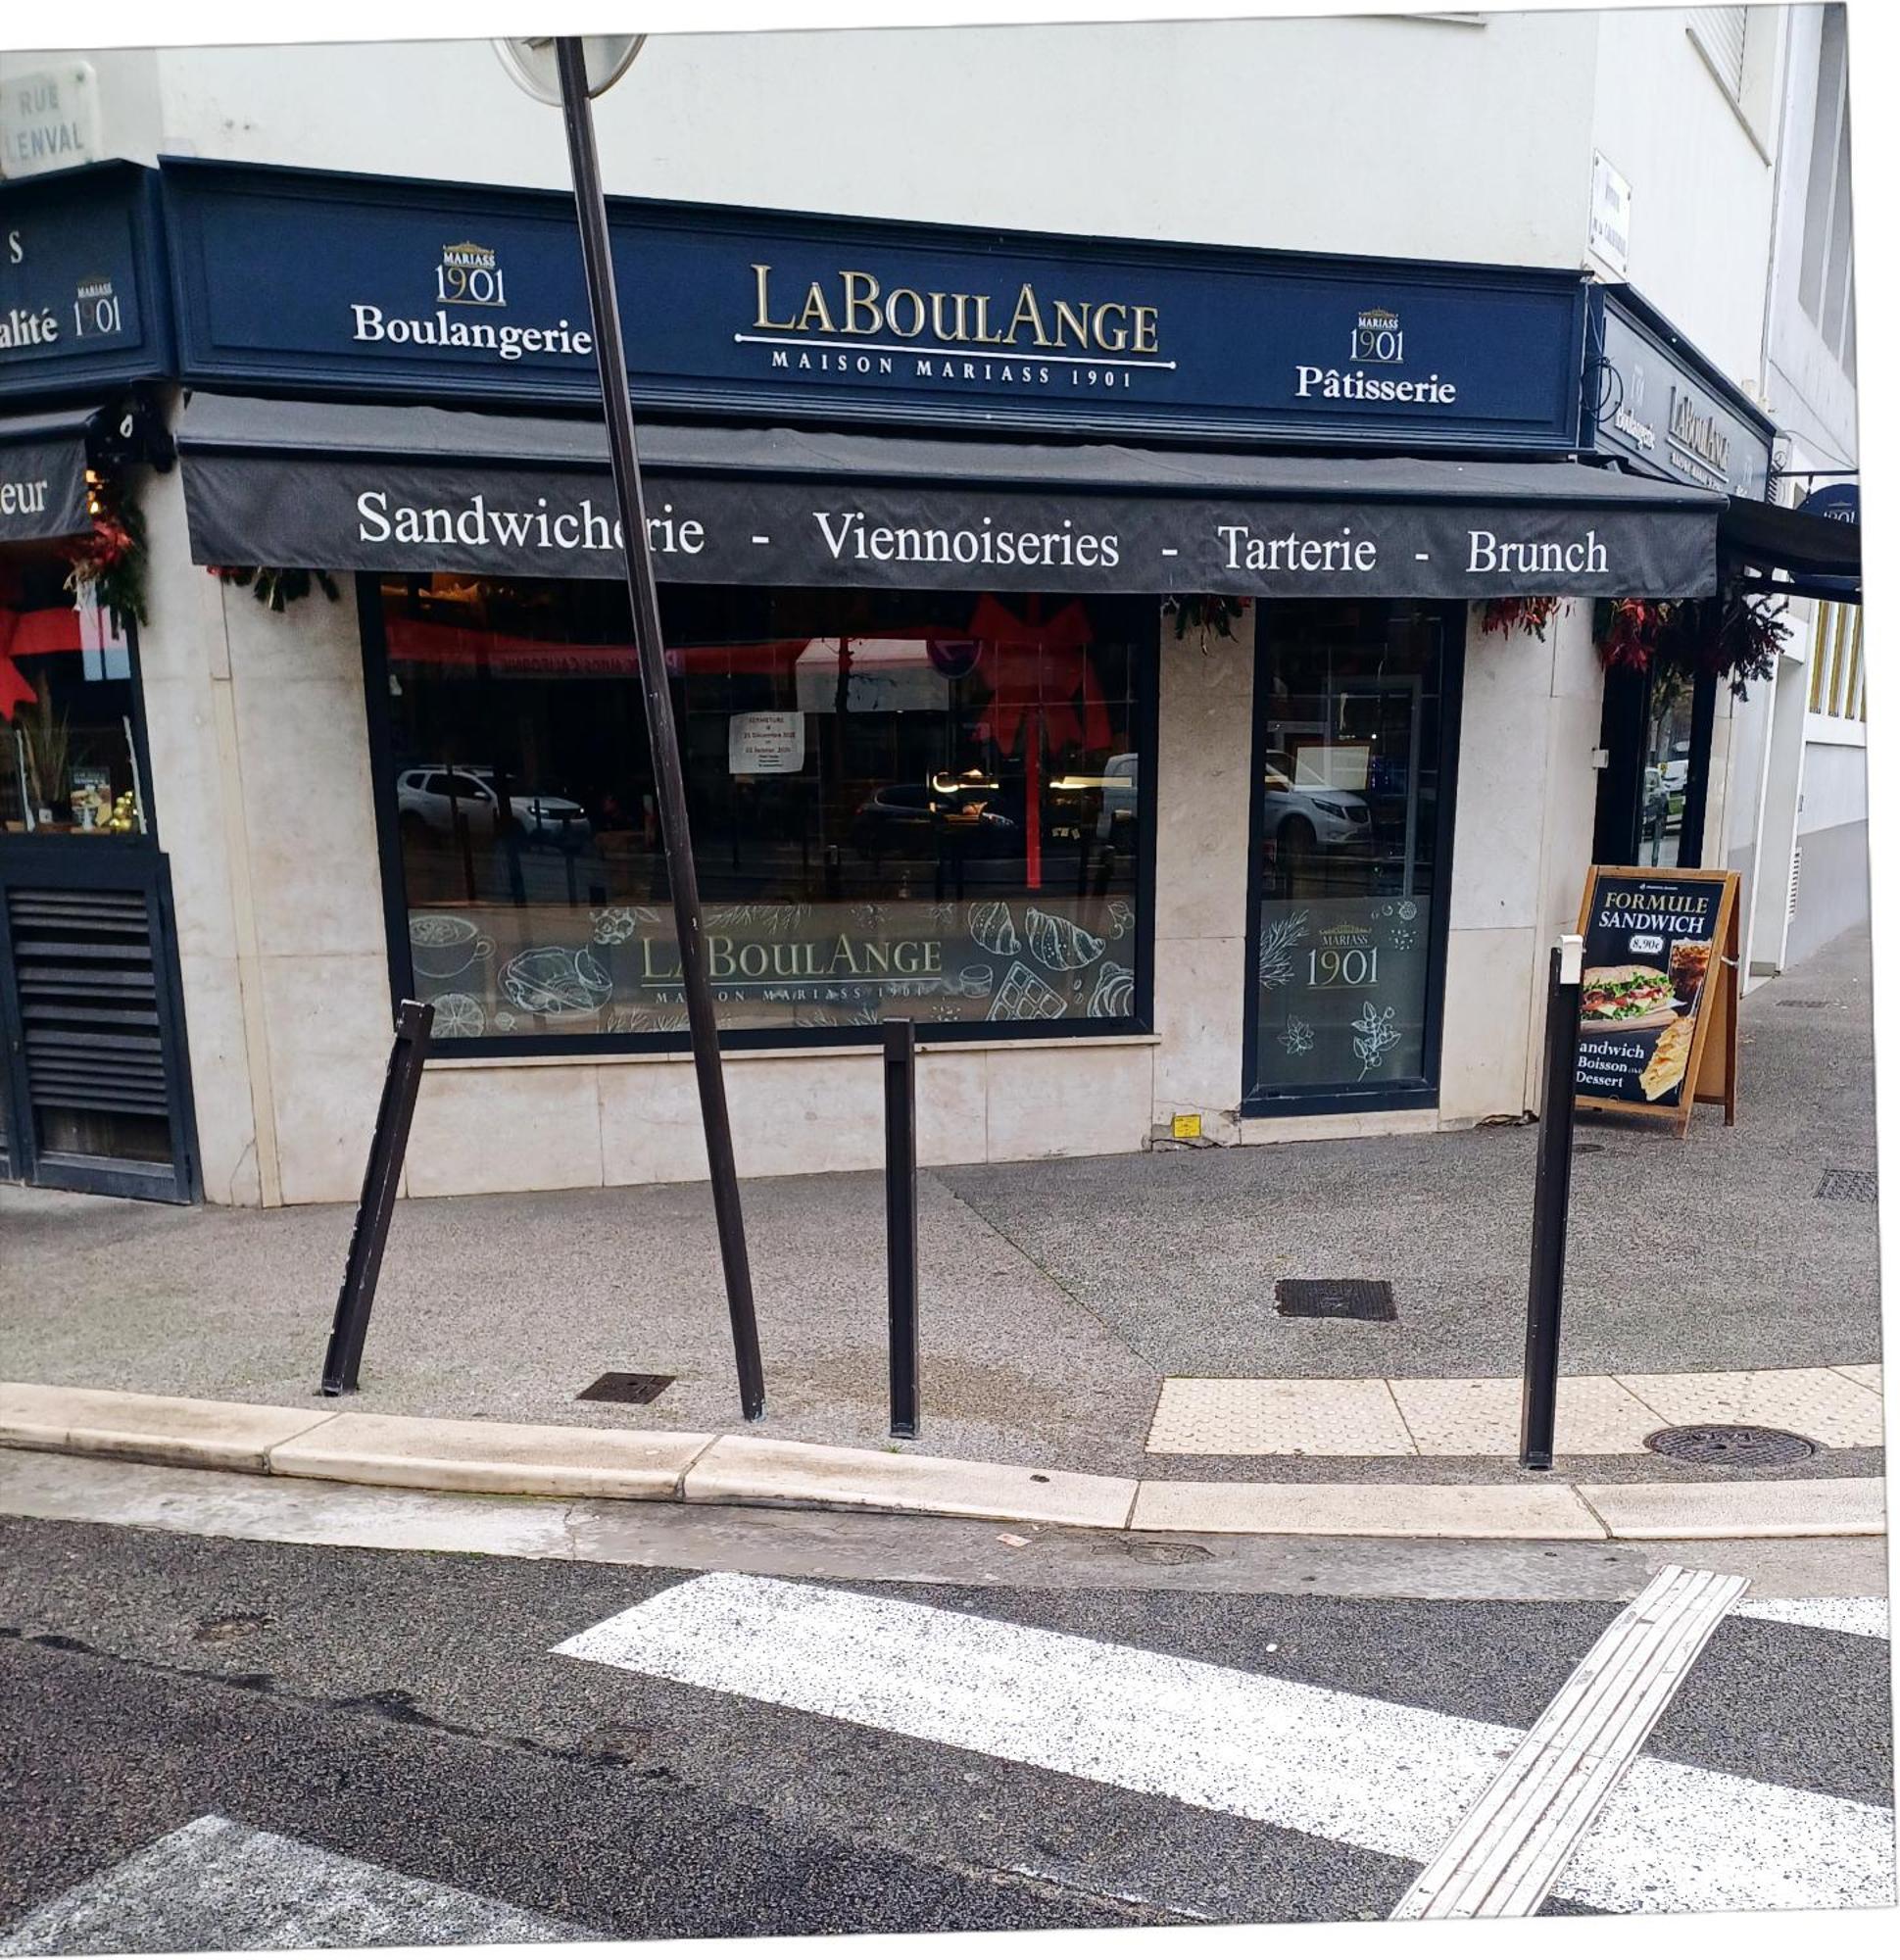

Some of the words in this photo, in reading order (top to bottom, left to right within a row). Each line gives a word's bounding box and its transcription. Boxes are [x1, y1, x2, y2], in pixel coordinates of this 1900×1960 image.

[20, 83, 60, 117] RUE
[443, 251, 496, 268] MARIASS
[435, 264, 506, 303] 1901
[351, 304, 593, 360] Boulangerie
[1358, 317, 1399, 330] MARIASS
[1349, 328, 1404, 361] 1901
[771, 350, 893, 374] MAISON
[916, 359, 1050, 384] MARIASS
[1071, 368, 1132, 388] 1901
[1294, 366, 1457, 404] Pâtisserie
[812, 511, 1119, 567] Viennoiseries
[1218, 526, 1378, 573] Tarterie
[1466, 530, 1610, 574] Brunch
[1604, 892, 1710, 914] FORMULE
[1598, 911, 1705, 934] SANDWICH
[1323, 934, 1369, 947] MARIASS
[1307, 946, 1378, 986] 1901
[655, 990, 746, 1004] MAON
[762, 988, 862, 1002] MARIASS
[878, 984, 923, 999] 1901
[1579, 1040, 1645, 1059] andwich
[1577, 1055, 1628, 1072] Boisson
[1576, 1071, 1624, 1088] Dessert
